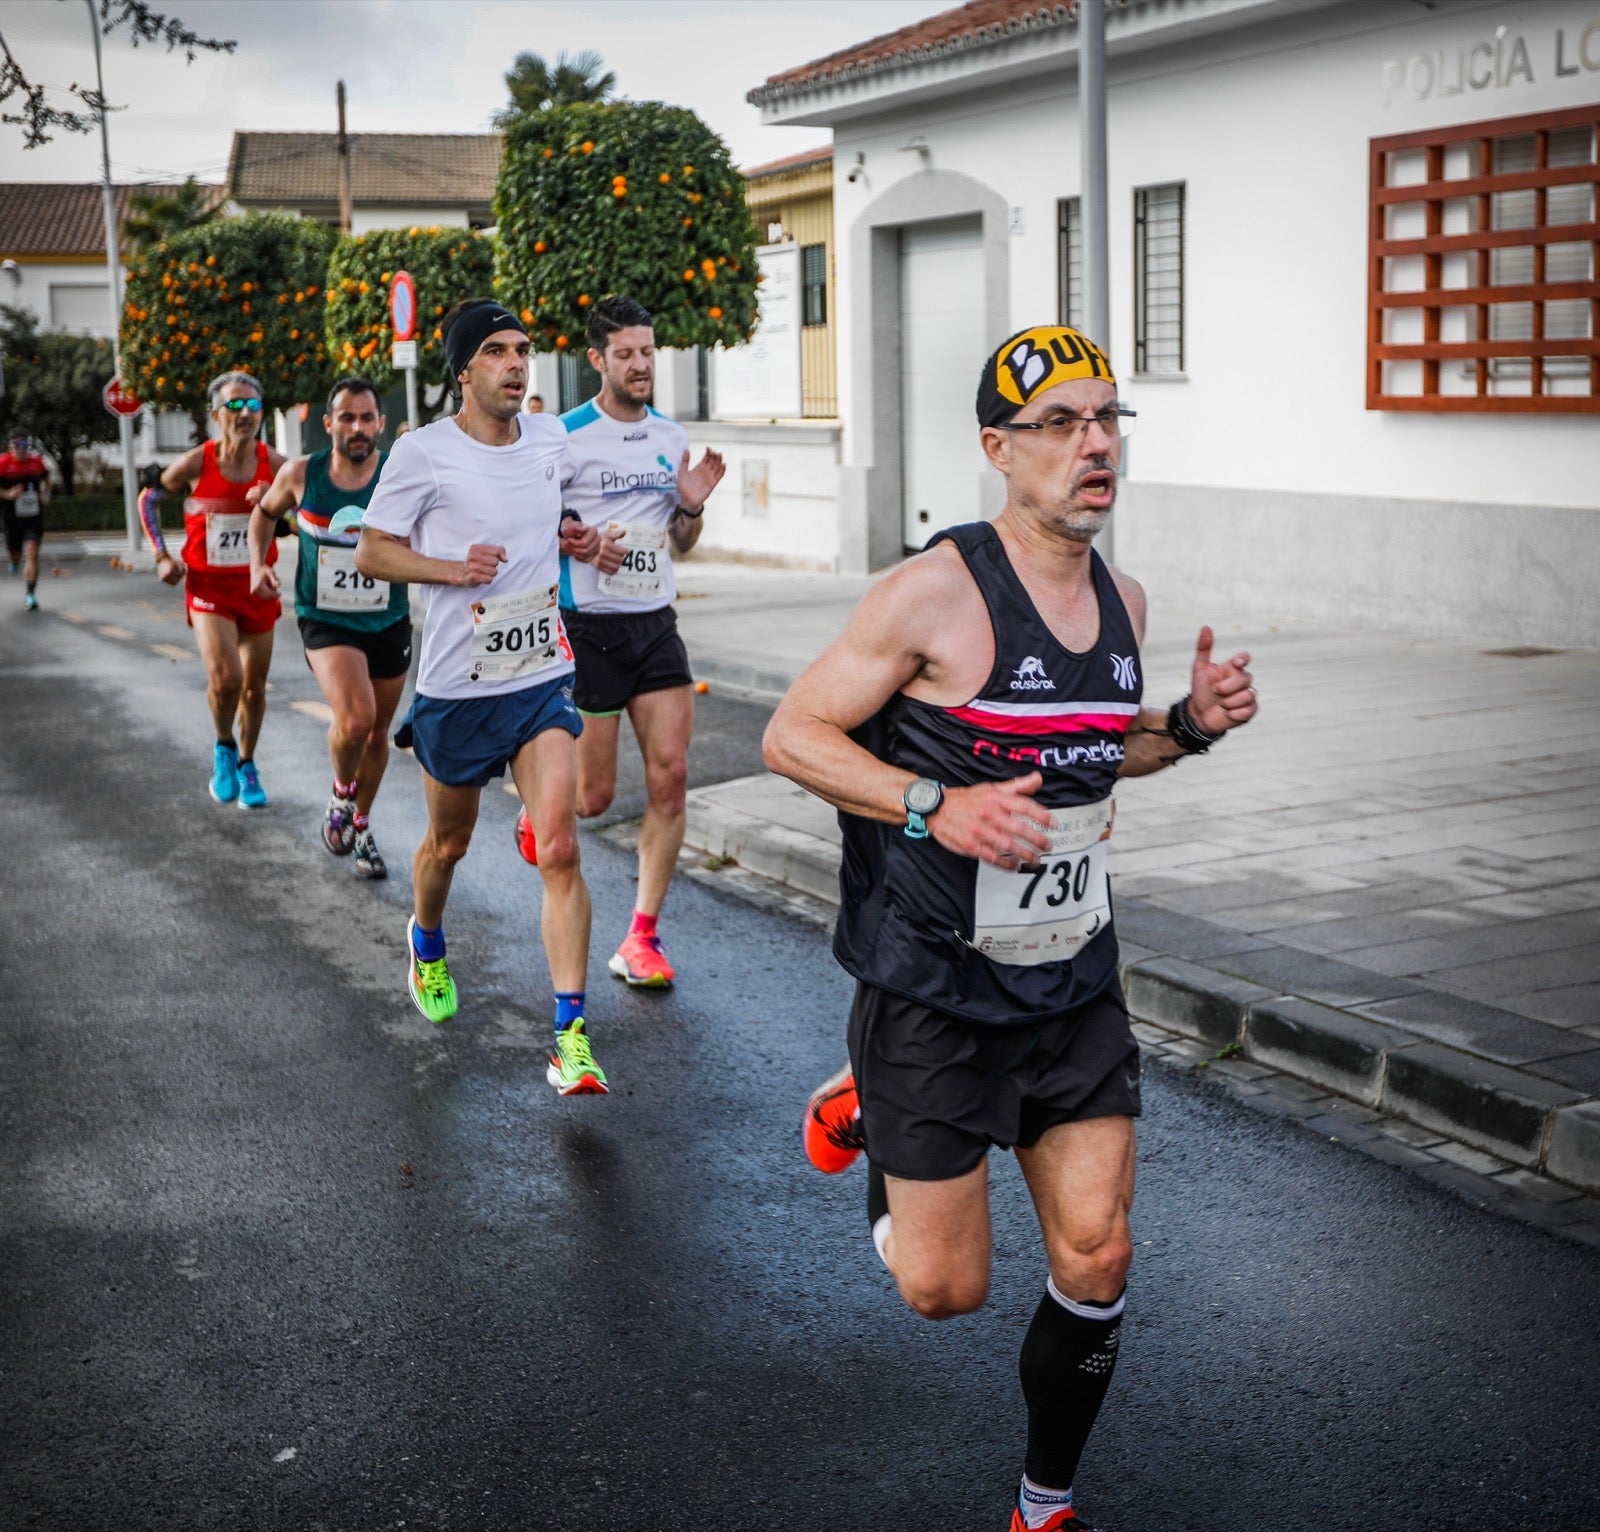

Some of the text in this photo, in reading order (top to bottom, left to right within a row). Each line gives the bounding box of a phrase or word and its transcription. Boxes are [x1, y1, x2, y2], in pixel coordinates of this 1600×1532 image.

[1383, 24, 1536, 107] POLICÍA
[219, 529, 248, 547] 27
[485, 617, 550, 652] 3015
[1017, 855, 1090, 909] 730
